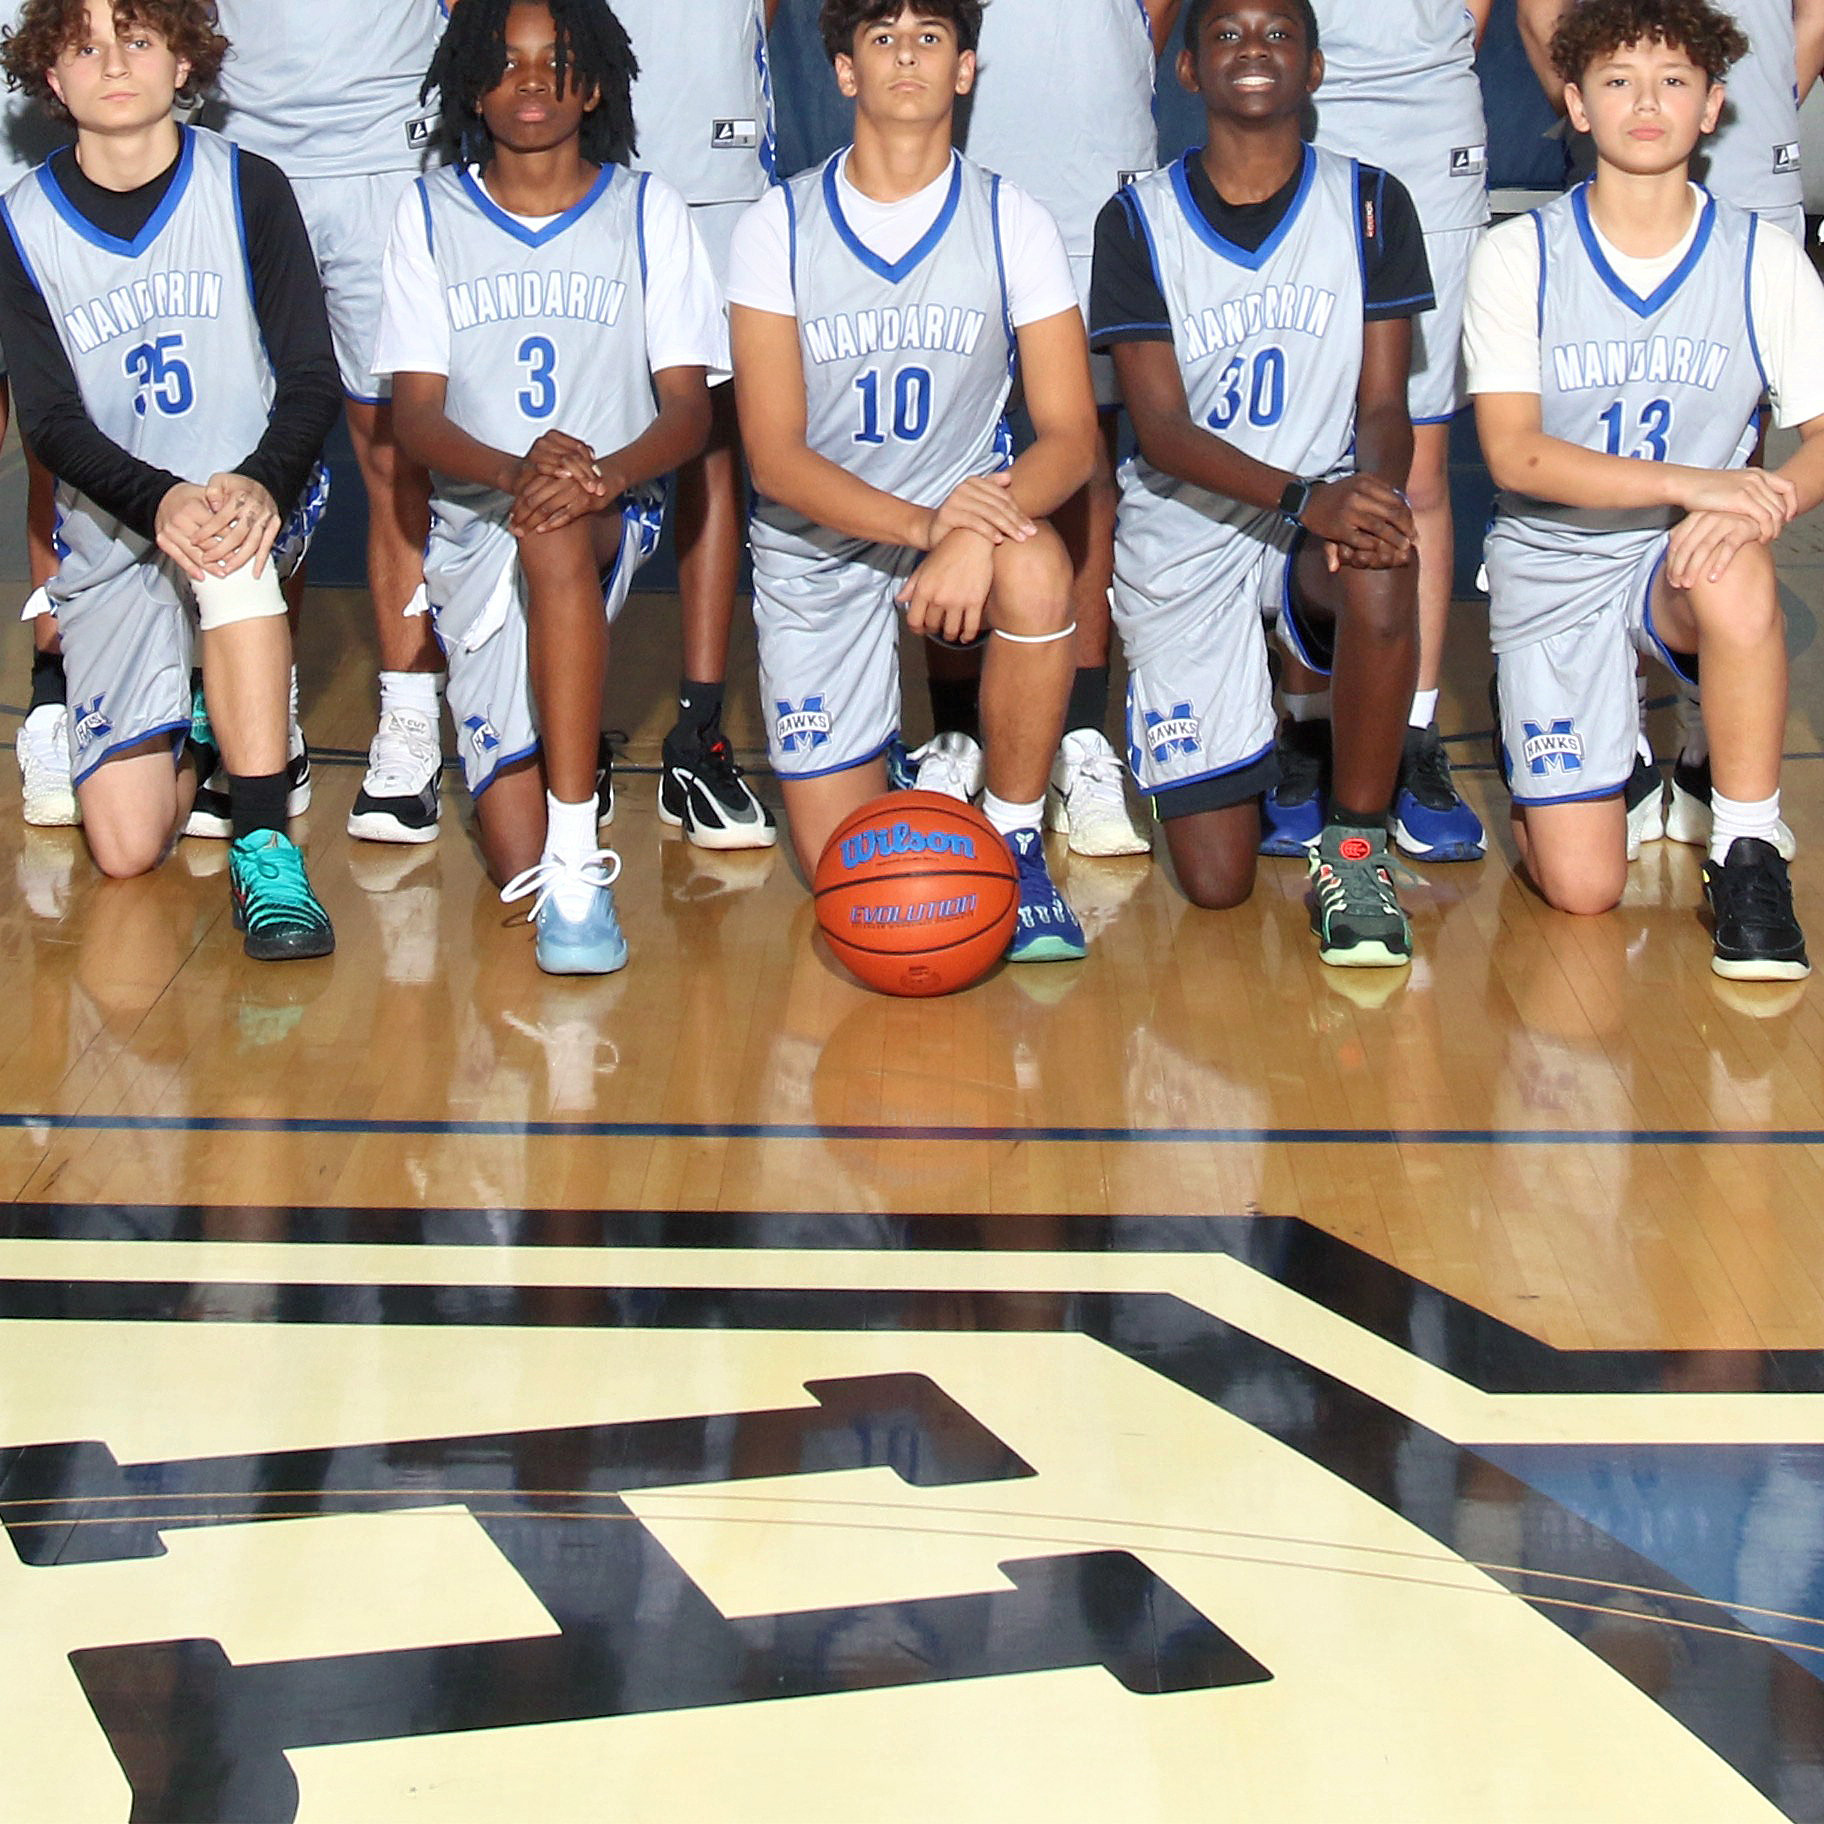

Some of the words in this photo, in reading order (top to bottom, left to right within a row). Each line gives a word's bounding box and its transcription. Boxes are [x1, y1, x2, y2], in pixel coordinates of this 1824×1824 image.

[447, 270, 627, 332] MANDARIN
[803, 303, 986, 365] MANDARIN
[1552, 335, 1730, 392] MANDARIN
[513, 332, 560, 422] 3
[852, 363, 934, 447] 10
[1204, 343, 1289, 433] 30
[1598, 395, 1674, 462] 13
[778, 714, 827, 736] HAWKS
[1147, 721, 1197, 746] HAWKS
[1526, 736, 1578, 757] HAWKS
[839, 822, 977, 870] Wilson
[849, 893, 978, 924] EVOLUTION
